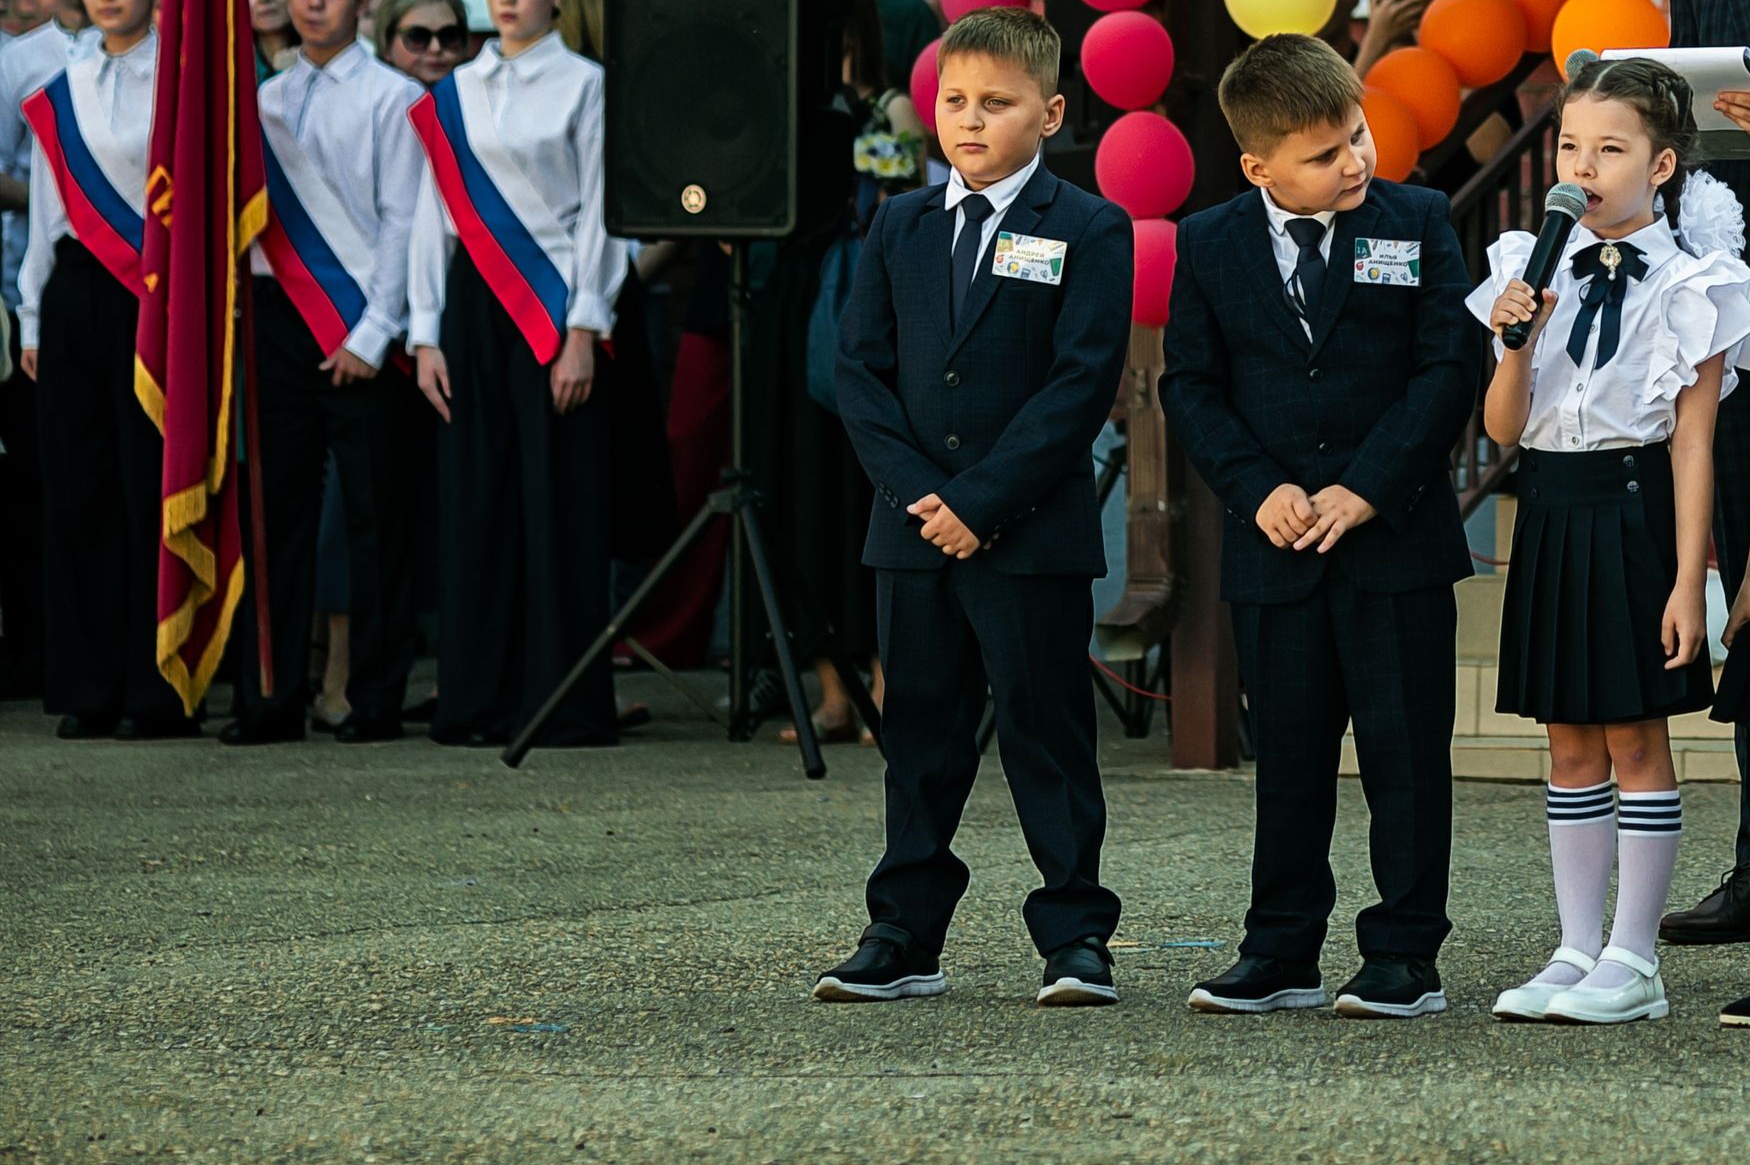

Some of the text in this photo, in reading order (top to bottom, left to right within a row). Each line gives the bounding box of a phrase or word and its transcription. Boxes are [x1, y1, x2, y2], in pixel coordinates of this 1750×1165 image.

[1016, 248, 1046, 259] АНДРЕЙ
[1008, 254, 1050, 266] АНИЩЕНКО
[1368, 259, 1409, 268] АНИЩЕНКО
